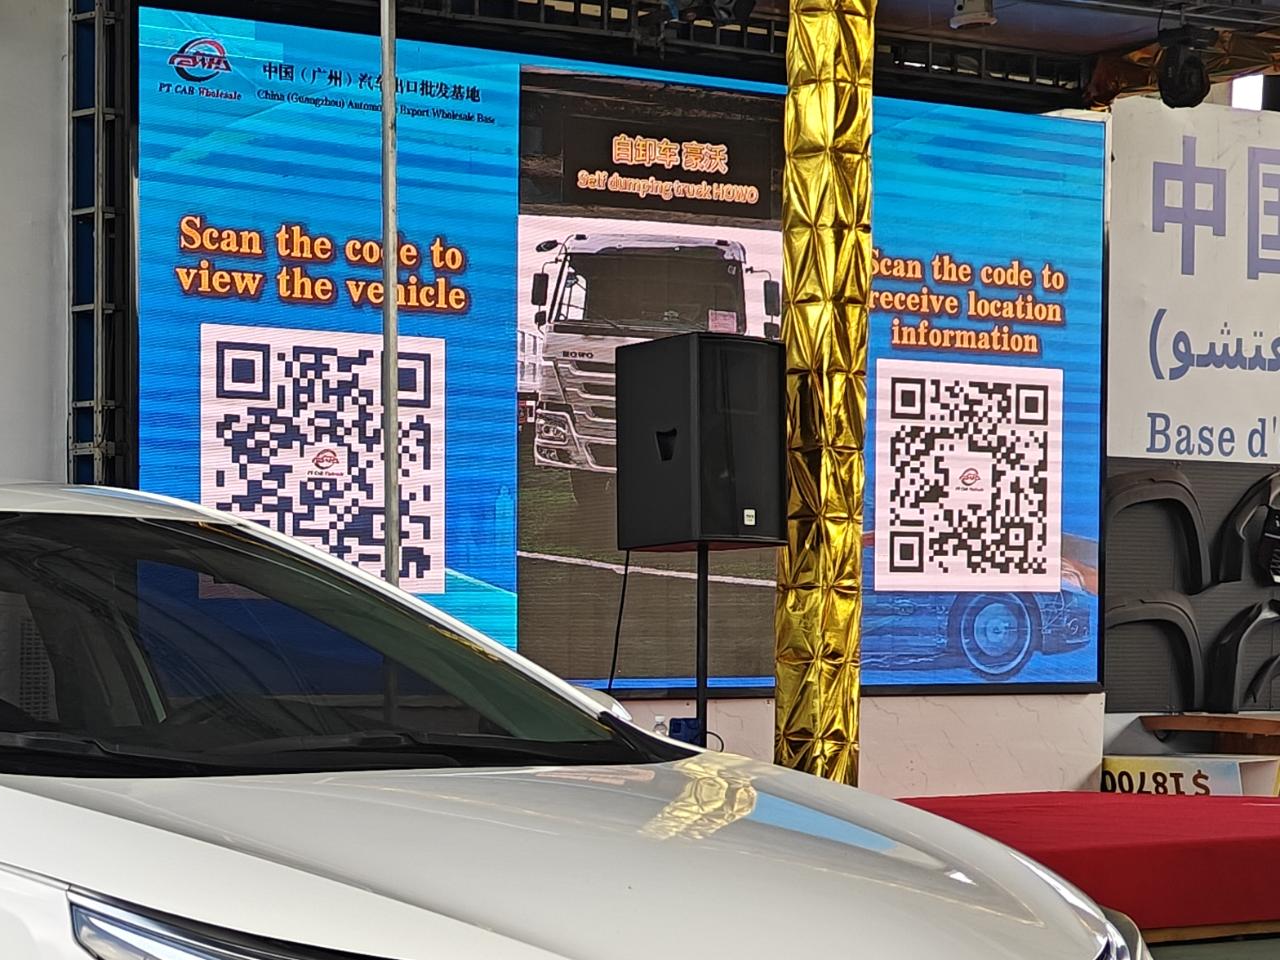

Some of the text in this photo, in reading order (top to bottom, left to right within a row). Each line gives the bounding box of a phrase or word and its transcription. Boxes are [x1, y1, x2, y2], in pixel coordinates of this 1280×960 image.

[199, 87, 241, 100] Wholesale
[257, 88, 285, 101] China
[287, 92, 345, 108] (Guangzhou)
[400, 104, 429, 117] Export
[431, 107, 474, 121] Wholesale
[477, 112, 495, 124] Base
[613, 134, 728, 174] 自卸车 豪沃
[577, 170, 759, 204] Self dumping truck HOWO
[180, 216, 463, 270] Scan the coe to
[176, 260, 263, 295] view
[277, 267, 332, 300] the
[932, 255, 971, 282] the
[980, 260, 1033, 287] code
[1042, 264, 1065, 290] to
[869, 287, 1062, 322] receive location
[891, 318, 1038, 353] information
[1146, 412, 1235, 457] Base
